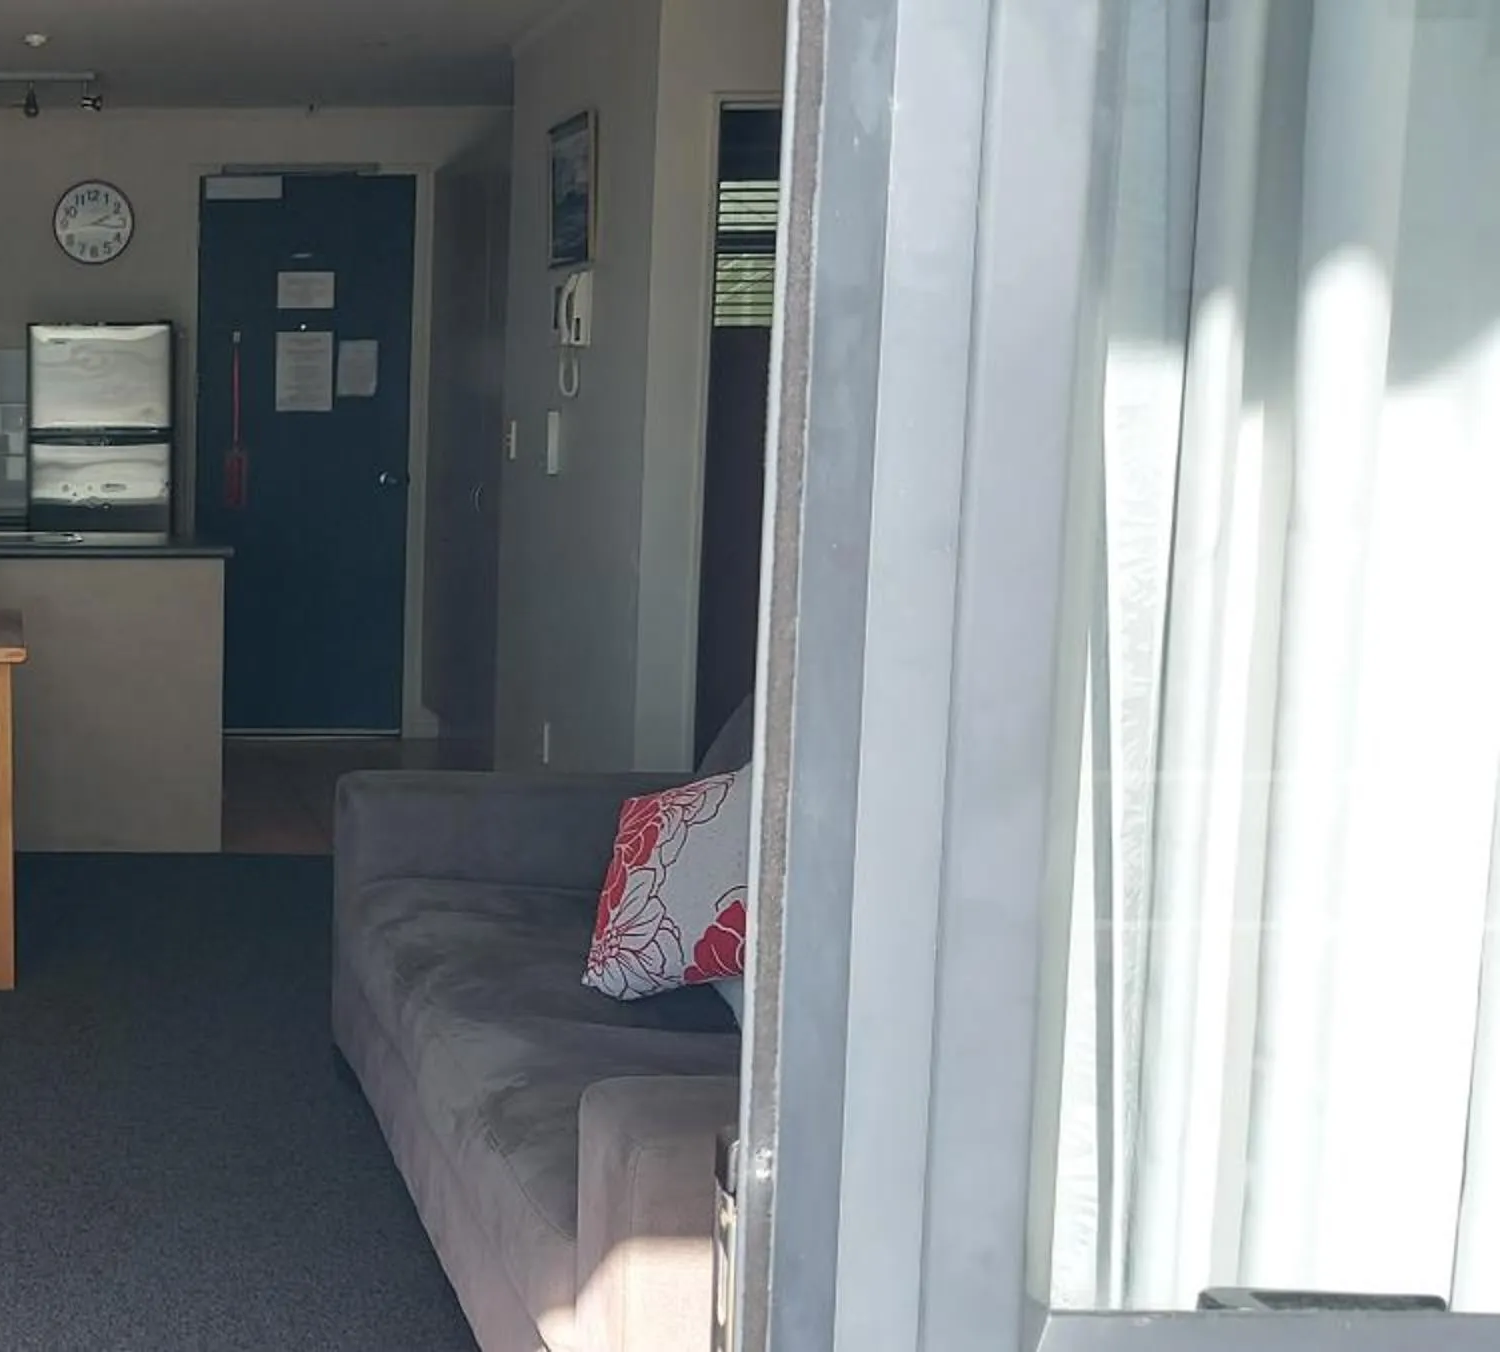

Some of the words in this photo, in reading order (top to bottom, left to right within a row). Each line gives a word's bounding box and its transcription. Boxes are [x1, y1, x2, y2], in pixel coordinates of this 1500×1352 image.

[75, 194, 85, 205] 11
[87, 189, 100, 200] 12
[103, 241, 112, 254] 5
